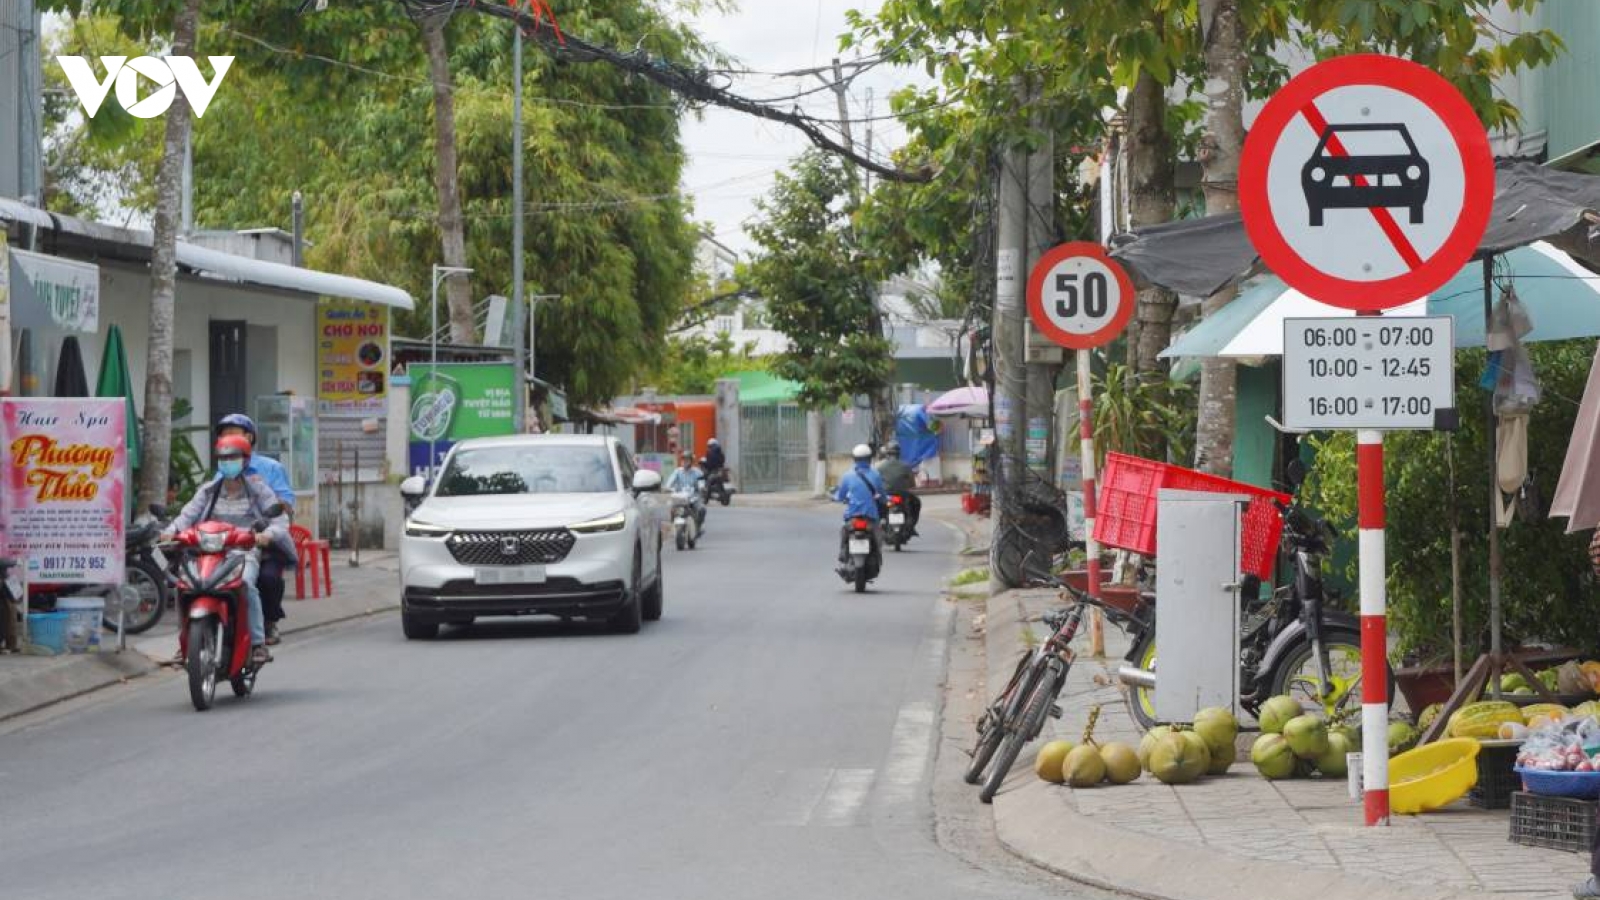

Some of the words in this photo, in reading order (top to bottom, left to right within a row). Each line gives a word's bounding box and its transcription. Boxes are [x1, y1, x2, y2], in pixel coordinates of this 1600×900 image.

[1056, 271, 1107, 317] 50
[1304, 327, 1357, 347] 06:00
[1380, 327, 1433, 346] 07:00
[1308, 358, 1357, 377] 10:00
[1381, 358, 1431, 377] 12:45
[1308, 397, 1358, 415] 16:00
[1381, 397, 1431, 415] 17:00
[43, 557, 67, 569] 0917
[69, 557, 85, 569] 752
[89, 557, 105, 569] 952
